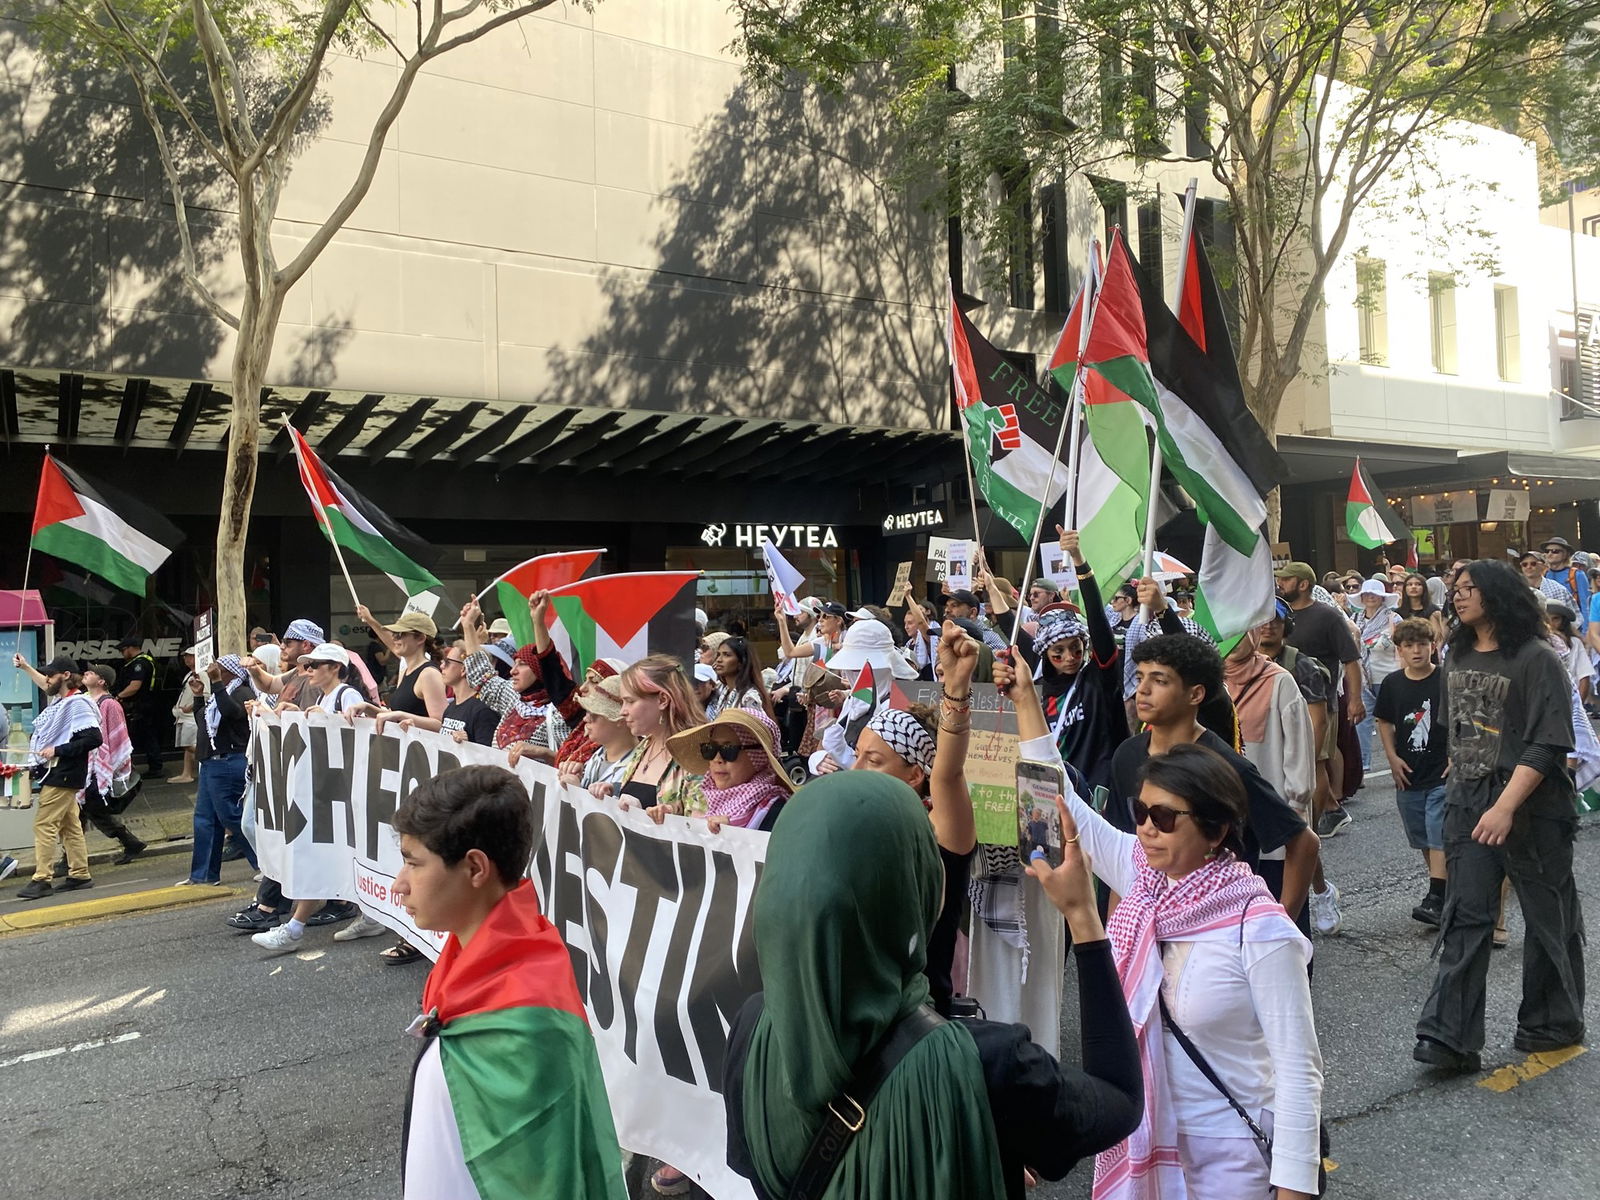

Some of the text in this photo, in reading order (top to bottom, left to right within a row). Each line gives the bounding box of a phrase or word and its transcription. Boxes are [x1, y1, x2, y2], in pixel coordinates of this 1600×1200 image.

[988, 360, 1062, 427] FREE
[897, 509, 944, 530] HEYTEA
[735, 525, 839, 548] HEYTEA
[55, 638, 182, 660] RISBNE
[979, 786, 993, 799] to
[356, 868, 387, 901] ustice
